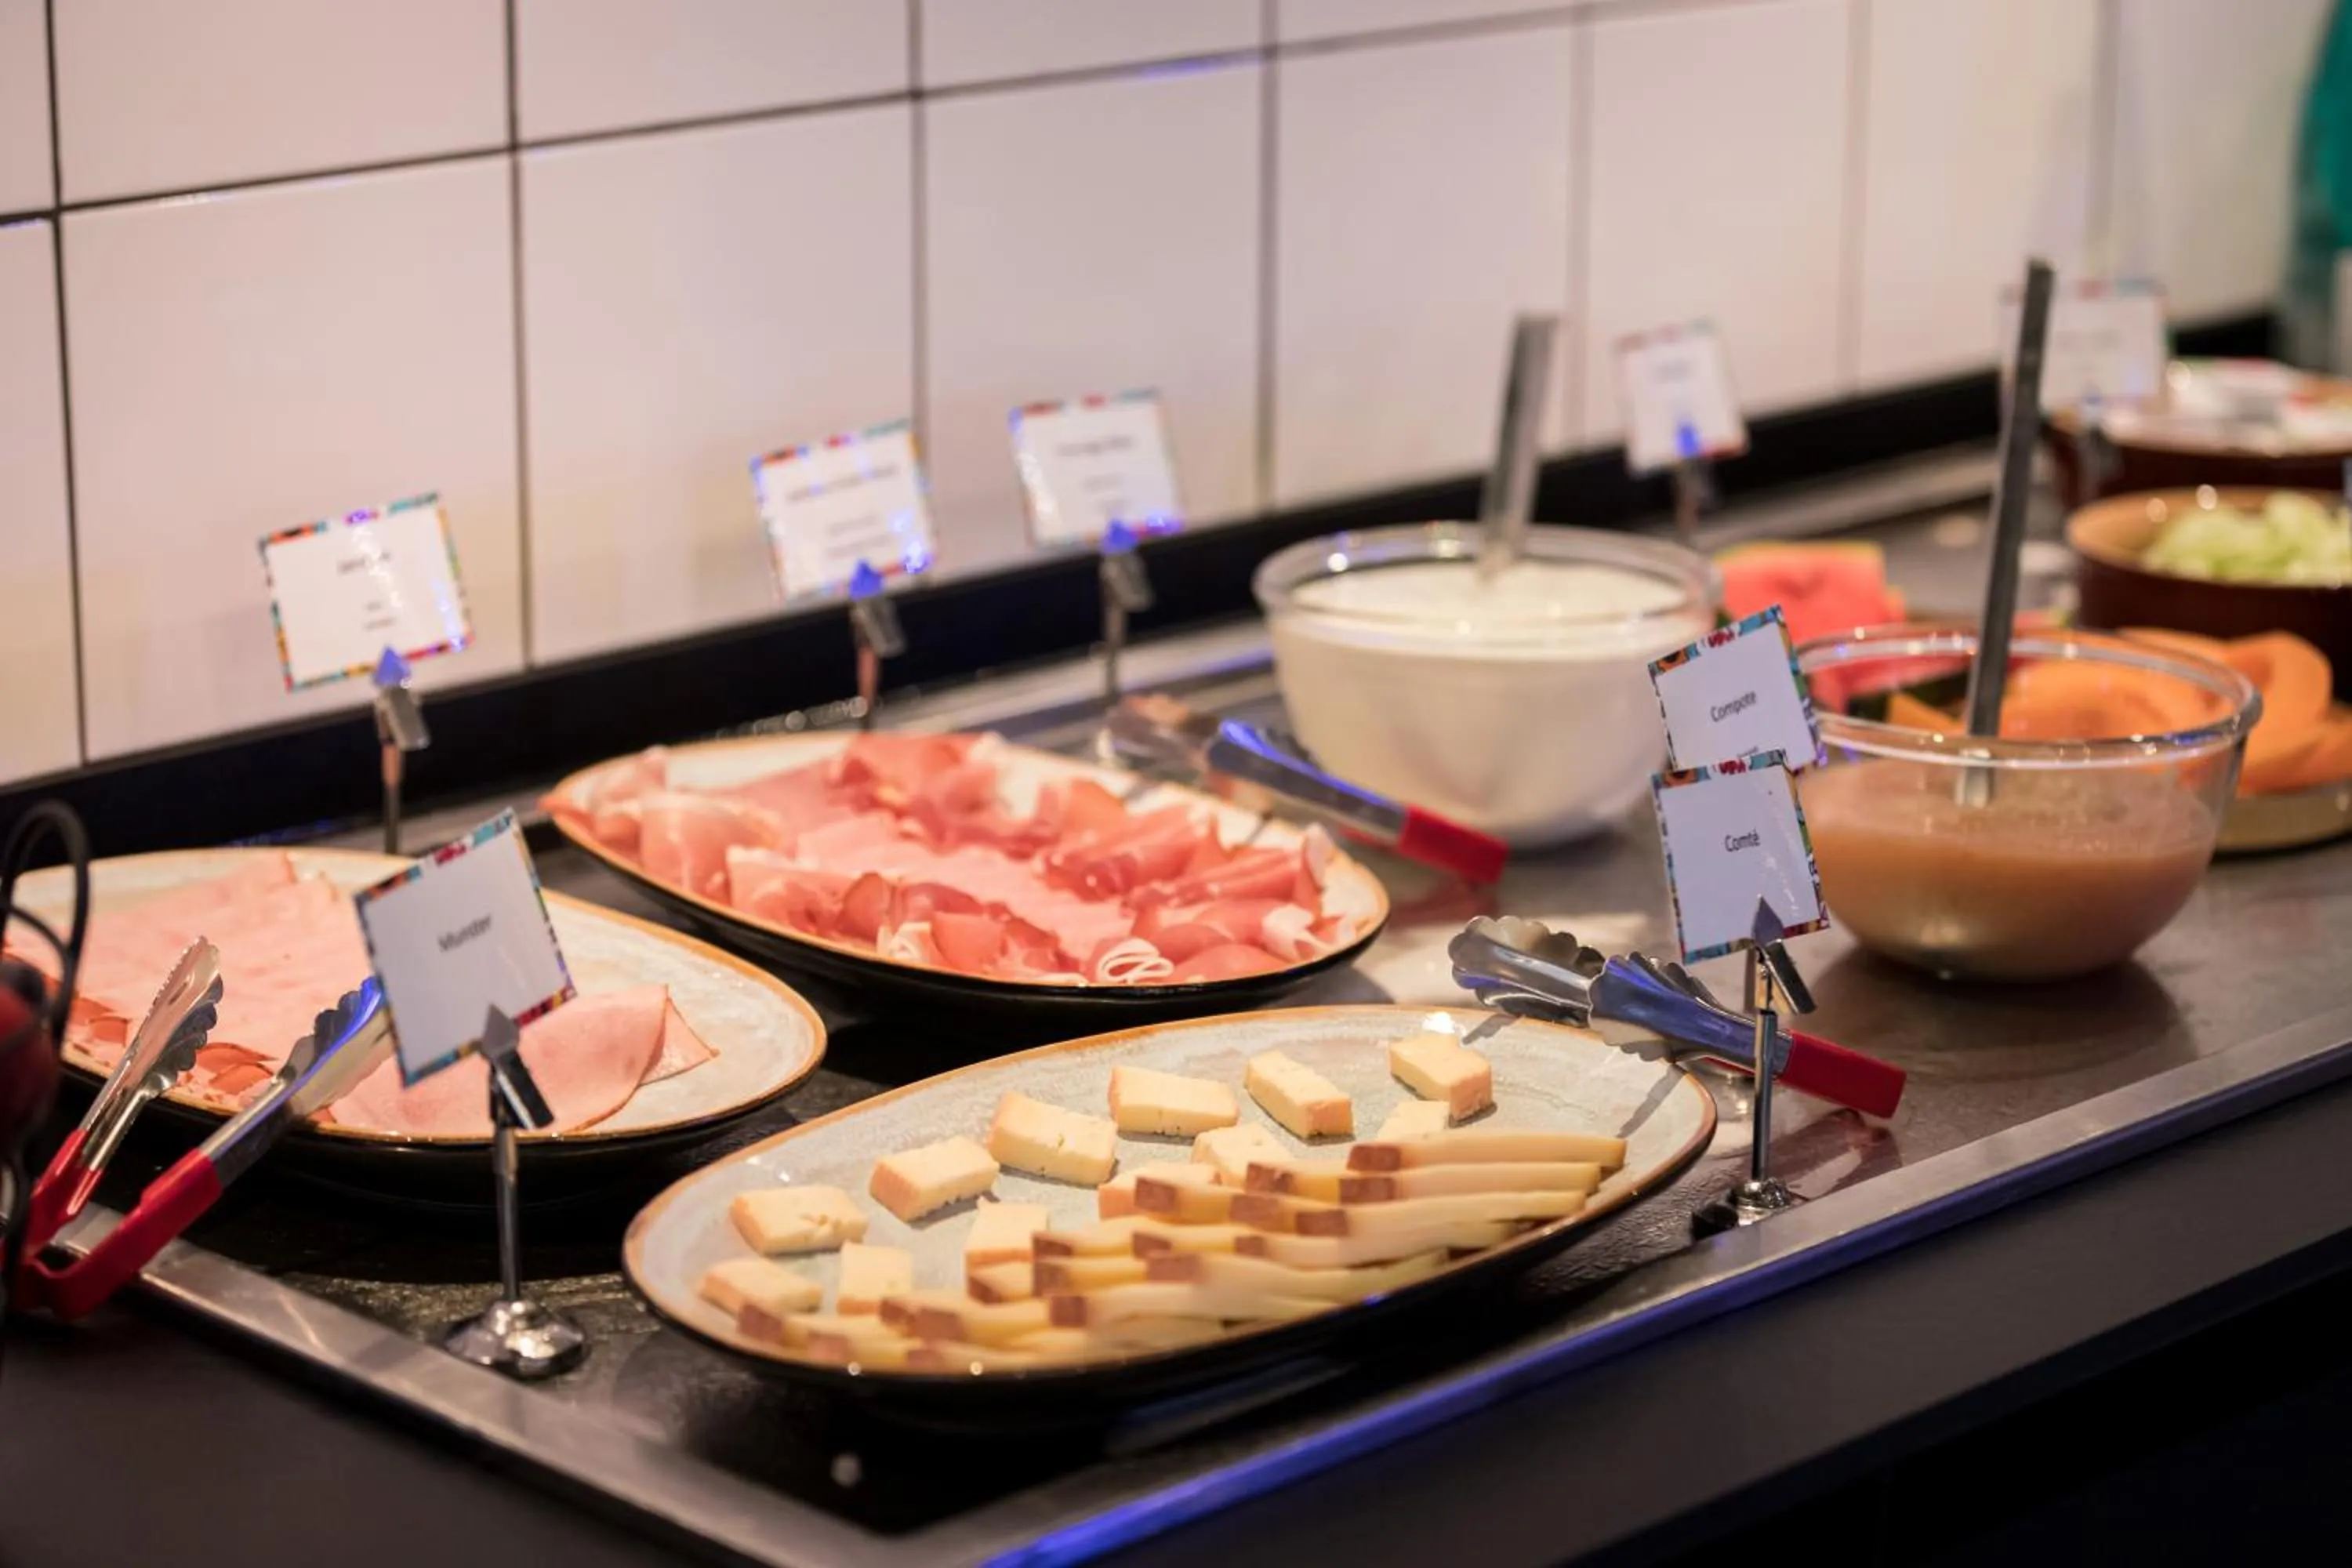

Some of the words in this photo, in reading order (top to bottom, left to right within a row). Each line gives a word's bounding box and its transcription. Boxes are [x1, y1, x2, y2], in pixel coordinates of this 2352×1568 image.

[1711, 691, 1757, 722] Compote
[1725, 828, 1761, 852] Comté
[437, 915, 492, 951] Munster
